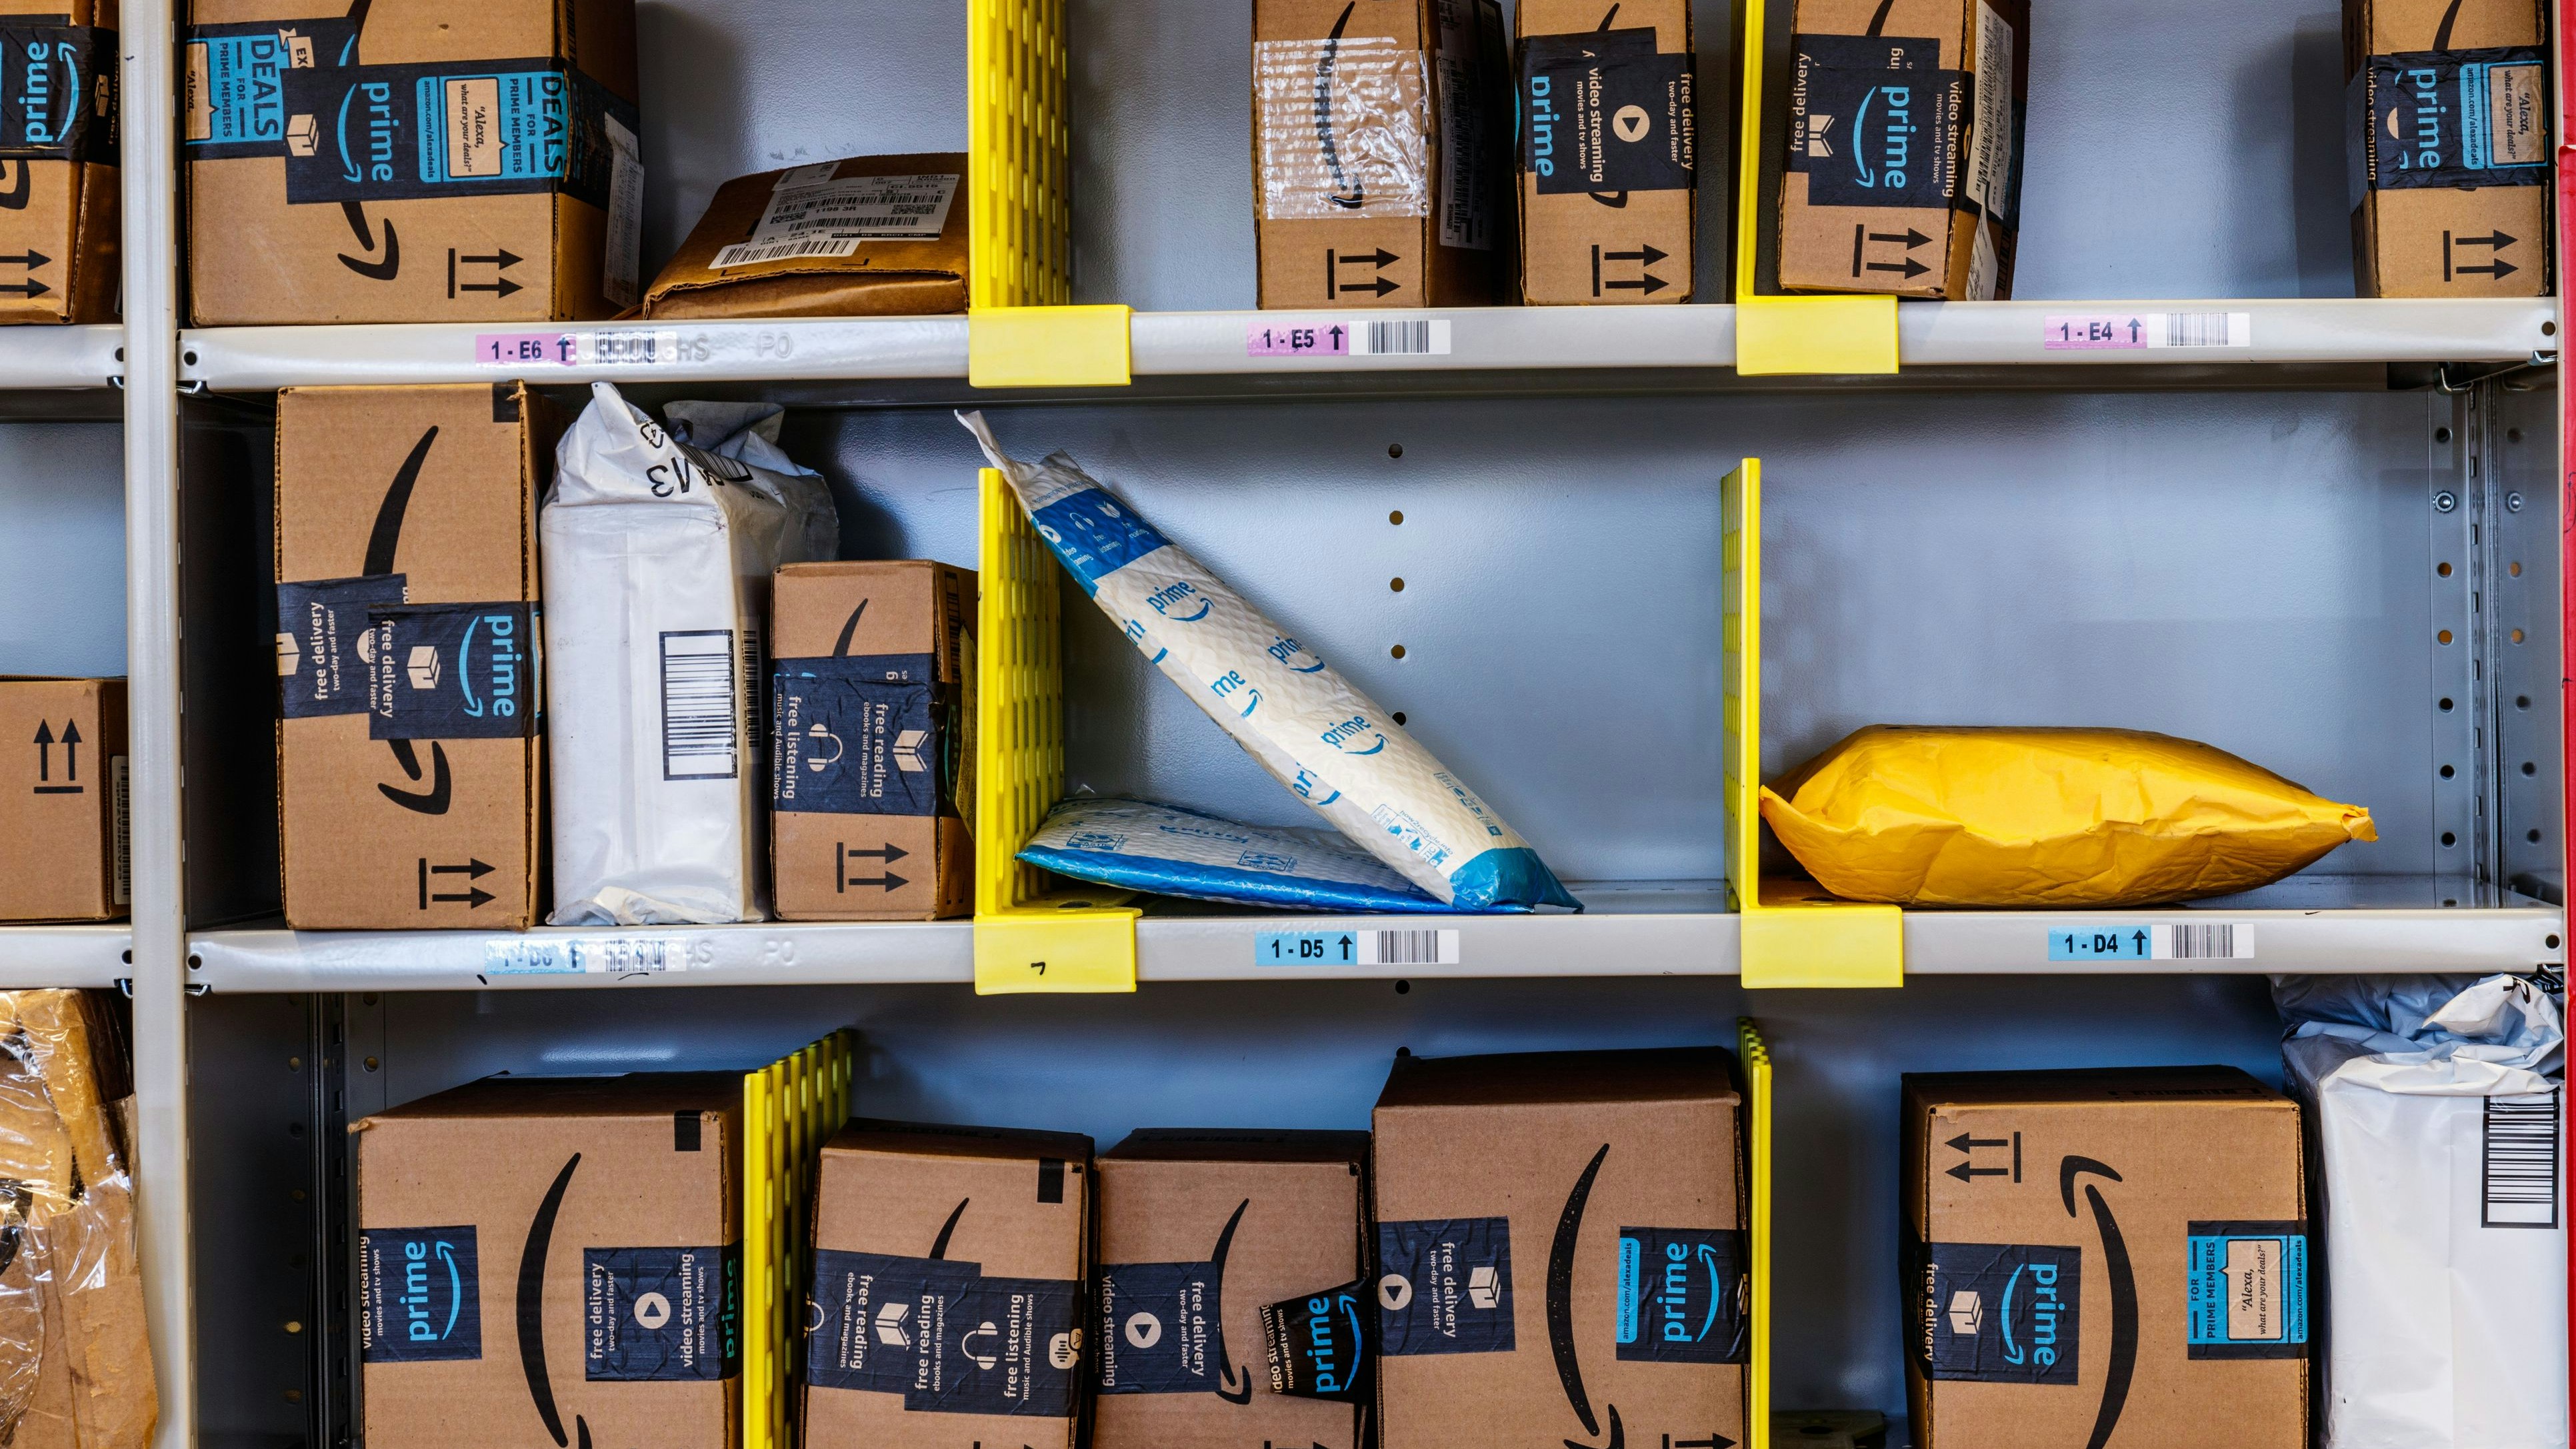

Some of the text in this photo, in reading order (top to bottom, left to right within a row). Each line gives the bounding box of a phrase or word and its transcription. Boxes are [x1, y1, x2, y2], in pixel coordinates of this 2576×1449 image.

[18, 41, 49, 143] prime
[219, 43, 232, 137] PRIME MEMBERS
[237, 78, 246, 101] FOR
[251, 40, 279, 136] DEALS
[460, 83, 469, 105] what
[527, 113, 536, 136] FOR
[541, 76, 565, 173] DEALS
[1577, 81, 1587, 169] movies and tv shows
[1589, 67, 1605, 182] video streaming
[1668, 81, 1677, 117] two-day
[1681, 73, 1694, 170] free delivery
[1791, 53, 1812, 152] free delivery
[1935, 94, 1943, 125] movies
[2408, 69, 2446, 168] prime
[2467, 67, 2478, 166] amazon.com/alexadeals
[2504, 70, 2513, 92] what
[2504, 108, 2513, 127] your
[361, 81, 399, 182] prime
[424, 81, 435, 178] amazon.com/alexadeals
[460, 121, 469, 141] your
[510, 79, 523, 173] PRIME MEMBERS
[1531, 76, 1560, 177] prime
[1881, 87, 1916, 189] prime
[1933, 157, 1941, 183] shows
[1935, 145, 1941, 154] tv
[1943, 81, 1963, 197] video streaming
[491, 340, 542, 359] 1 E6
[1263, 329, 1314, 348] 1 E5
[2061, 321, 2113, 341] 1 E4
[1145, 581, 1197, 615] prime
[310, 601, 328, 701] free delivery
[327, 609, 339, 691] two-day and faster
[368, 628, 377, 709] two-day and faster
[379, 619, 395, 717] free delivery
[484, 615, 522, 717] prime
[1267, 635, 1304, 665] prim
[783, 695, 801, 800] free listening
[861, 752, 869, 798] magazines
[870, 703, 888, 798] free reading
[1320, 715, 1371, 749] prime
[1271, 940, 1323, 958] 1 D5
[2065, 934, 2118, 953] 1 D4
[359, 1236, 371, 1349] video streaming
[374, 1288, 382, 1304] and
[375, 1277, 381, 1286] tv
[399, 1242, 437, 1341] prime
[589, 1263, 604, 1359] free delivery
[606, 1271, 614, 1296] faster
[679, 1254, 695, 1367] video streaming
[696, 1266, 705, 1354] movies and tv shows
[722, 1260, 735, 1358] prime
[1025, 1294, 1033, 1320] shows
[1179, 1290, 1188, 1324] two-day
[1430, 1250, 1439, 1284] two-day
[1442, 1242, 1457, 1338] free delivery
[1623, 1242, 1632, 1340] amazon.com/alexadeals
[1657, 1243, 1692, 1342] prime
[2191, 1279, 2199, 1301] FOR
[2206, 1242, 2216, 1338] PRIME MEMBERS
[2259, 1277, 2268, 1298] your
[2295, 1240, 2304, 1340] amazon.com/alexadeals
[375, 1306, 383, 1336] movies
[607, 1316, 616, 1352] two-day
[840, 1322, 850, 1369] magazines
[843, 1305, 851, 1320] and
[849, 1274, 873, 1370] free reading
[915, 1295, 934, 1390] free reading
[933, 1295, 944, 1392] ebooks and magazines
[1004, 1294, 1023, 1398] free listening
[1023, 1322, 1031, 1356] Audible
[1102, 1275, 1119, 1387] video streaming
[1181, 1342, 1189, 1368] faster
[1191, 1281, 1207, 1376] free delivery
[1277, 1309, 1294, 1389] movies and shows
[1307, 1297, 1340, 1392] prime
[1923, 1262, 1939, 1362] free delivery
[2029, 1264, 2065, 1366] prime
[2258, 1314, 2267, 1335] what
[1021, 1375, 1029, 1400] music
